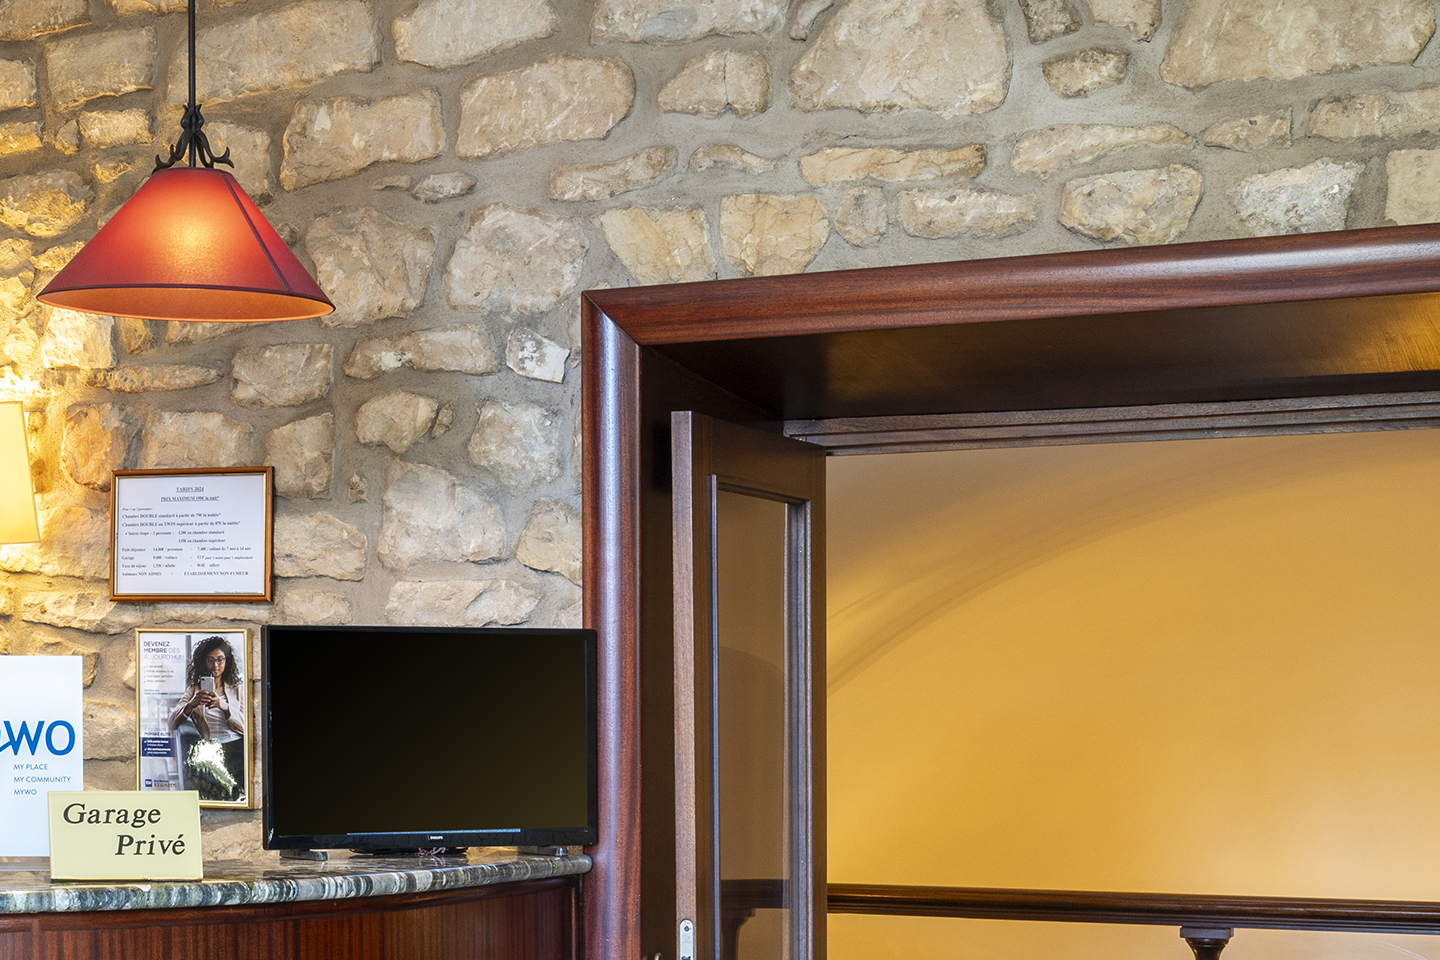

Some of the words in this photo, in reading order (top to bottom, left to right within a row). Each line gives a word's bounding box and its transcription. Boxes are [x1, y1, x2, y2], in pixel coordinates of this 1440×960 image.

[25, 763, 49, 771] PLACE
[13, 788, 38, 796] MYWO
[62, 803, 161, 829] Garage
[114, 833, 186, 856] Privé
